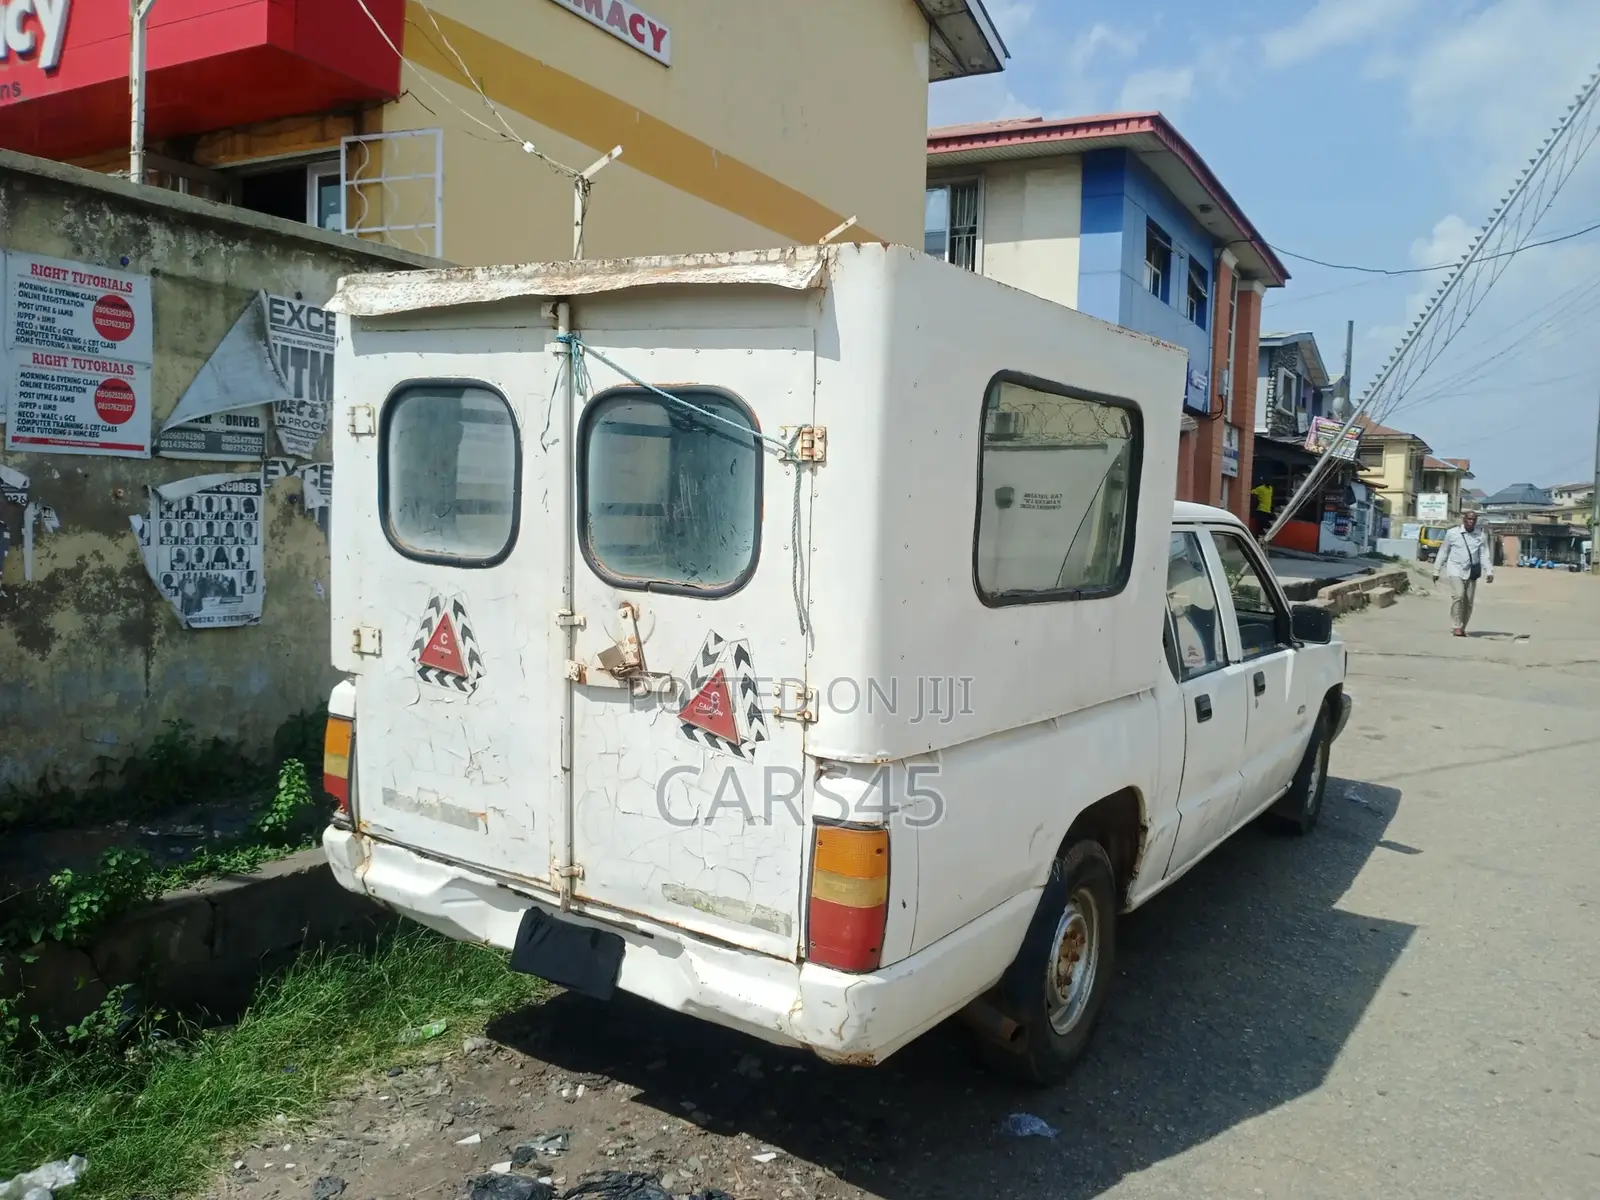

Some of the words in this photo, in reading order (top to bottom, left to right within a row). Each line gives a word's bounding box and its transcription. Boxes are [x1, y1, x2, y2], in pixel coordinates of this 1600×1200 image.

[31, 263, 69, 280] RIGHT
[72, 271, 133, 293] TUTORIALS
[18, 282, 48, 293] MORNING
[55, 288, 80, 299] EVENING
[81, 293, 98, 302] CLASS
[18, 291, 40, 300] ONLINE
[42, 294, 84, 308] REGISTRATION
[18, 301, 34, 310] POST
[35, 304, 51, 314] UTME
[17, 312, 36, 321] JUPEP
[16, 320, 34, 330] NECO
[40, 324, 56, 333] WAEC
[62, 327, 74, 336] GCE
[15, 336, 34, 345] HOME
[35, 338, 65, 350] TUTORING
[88, 345, 100, 354] REG
[16, 328, 49, 340] COMPUTER
[100, 341, 117, 350] CLASS
[32, 352, 68, 367] RIGHT
[72, 357, 134, 376] TUTORIALS
[20, 372, 49, 382] MORNING
[56, 375, 81, 385] EVENING
[20, 380, 42, 389] ONLINE
[44, 383, 86, 394] REGISTRATION
[17, 418, 51, 427] COMPUTER
[41, 412, 58, 421] WAEC
[226, 414, 260, 428] DRIVER
[36, 427, 66, 436] TUTORING
[220, 482, 258, 493] SCORES
[440, 633, 448, 644] C
[432, 644, 452, 655] CAUTION
